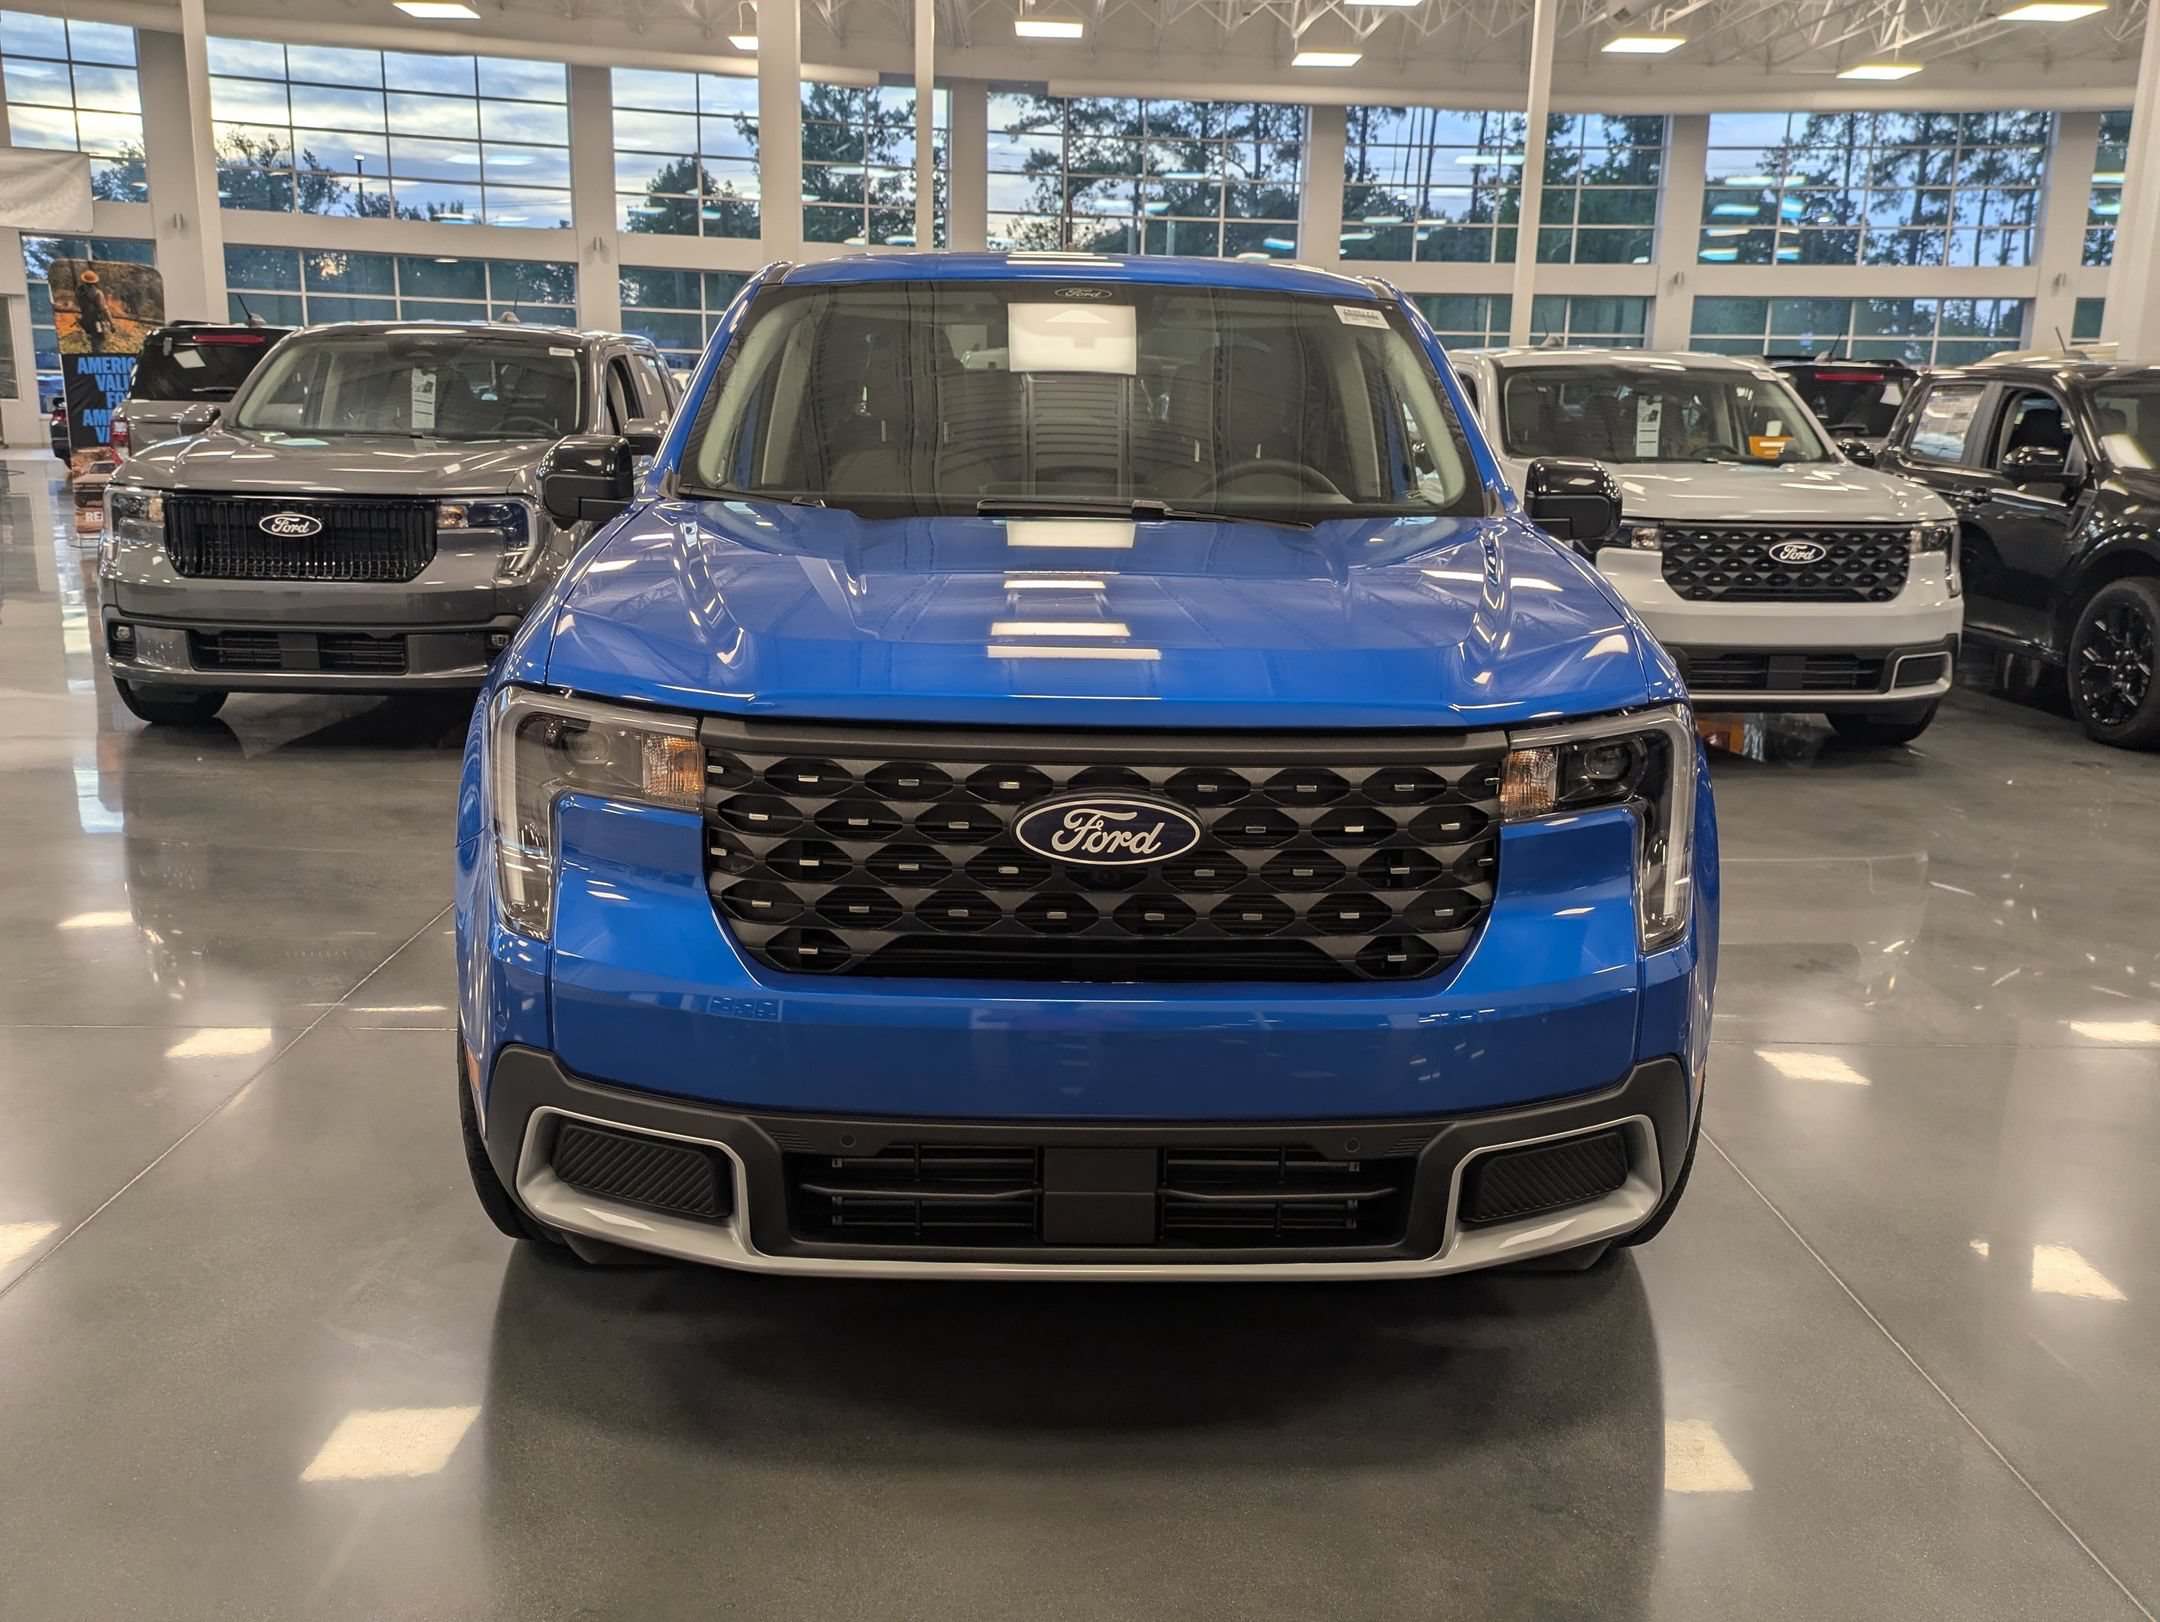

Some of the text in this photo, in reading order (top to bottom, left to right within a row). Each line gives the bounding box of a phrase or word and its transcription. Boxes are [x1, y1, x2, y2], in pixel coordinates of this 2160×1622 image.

[85, 511, 104, 523] RE
[271, 516, 310, 533] Ford
[1780, 544, 1816, 560] Ford
[1051, 808, 1165, 854] Ford
